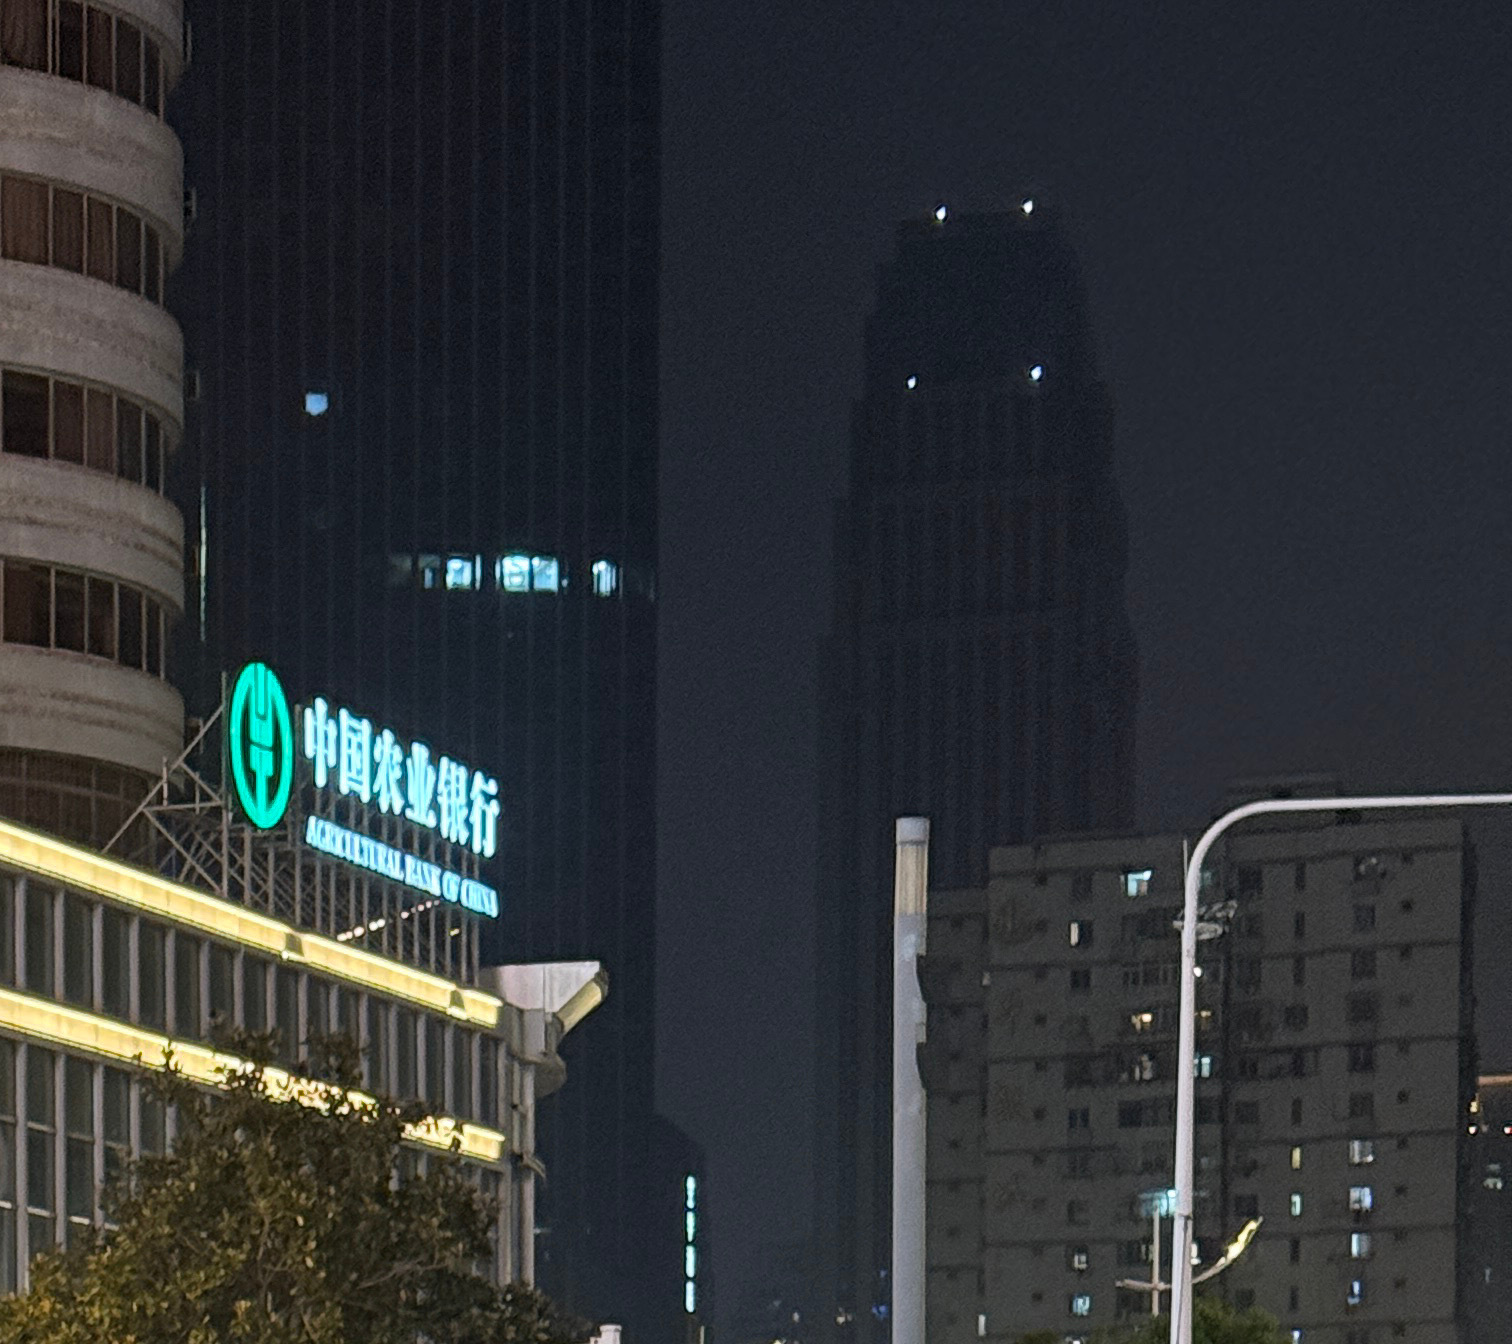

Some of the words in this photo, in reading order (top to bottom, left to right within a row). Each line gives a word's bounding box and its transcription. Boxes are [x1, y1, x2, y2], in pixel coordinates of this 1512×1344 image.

[304, 697, 500, 858] 中国农业银行
[305, 815, 405, 882] AGRICULTURAL
[405, 854, 442, 897] BANK
[442, 870, 461, 903] OF
[460, 878, 499, 918] CHINA
